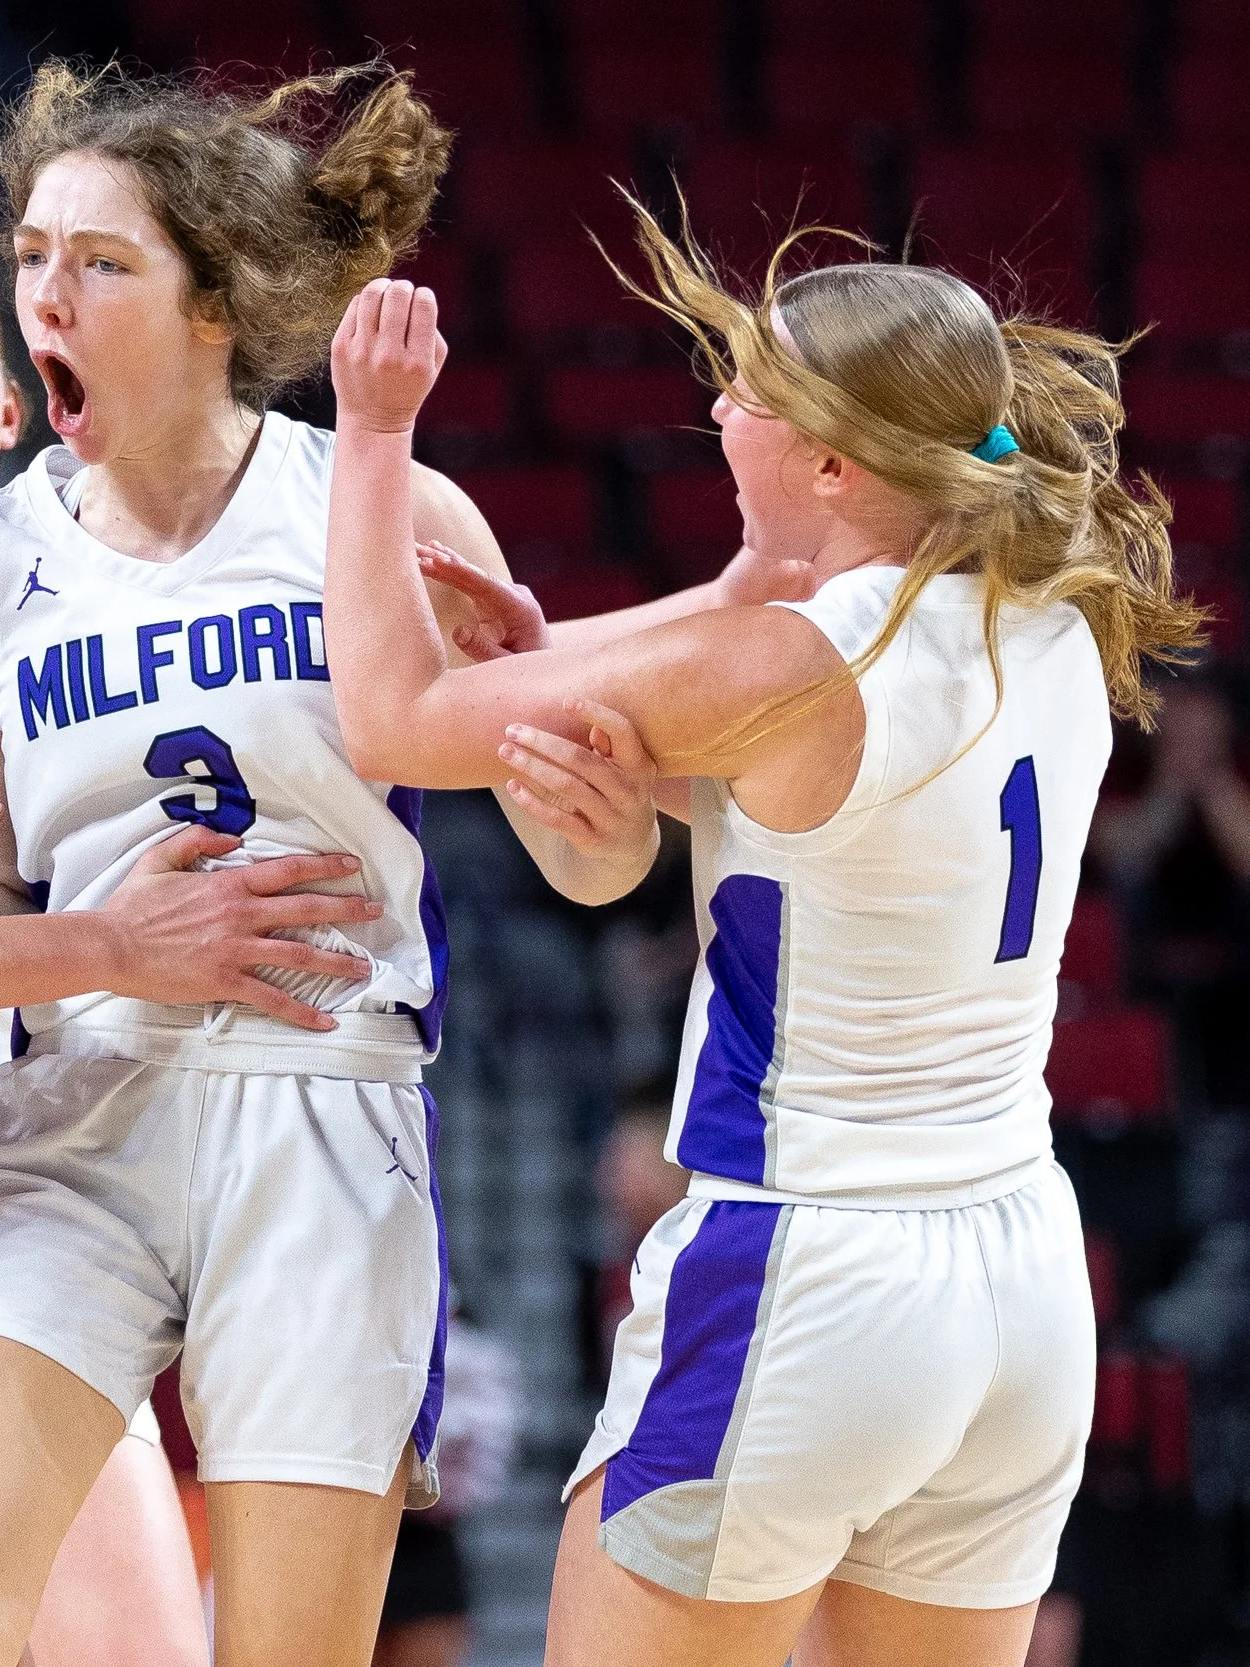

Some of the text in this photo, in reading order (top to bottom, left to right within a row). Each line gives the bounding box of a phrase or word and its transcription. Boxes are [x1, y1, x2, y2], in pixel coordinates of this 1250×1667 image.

[17, 602, 330, 742] MILFORD
[143, 725, 256, 837] 3
[993, 754, 1043, 964] 1
